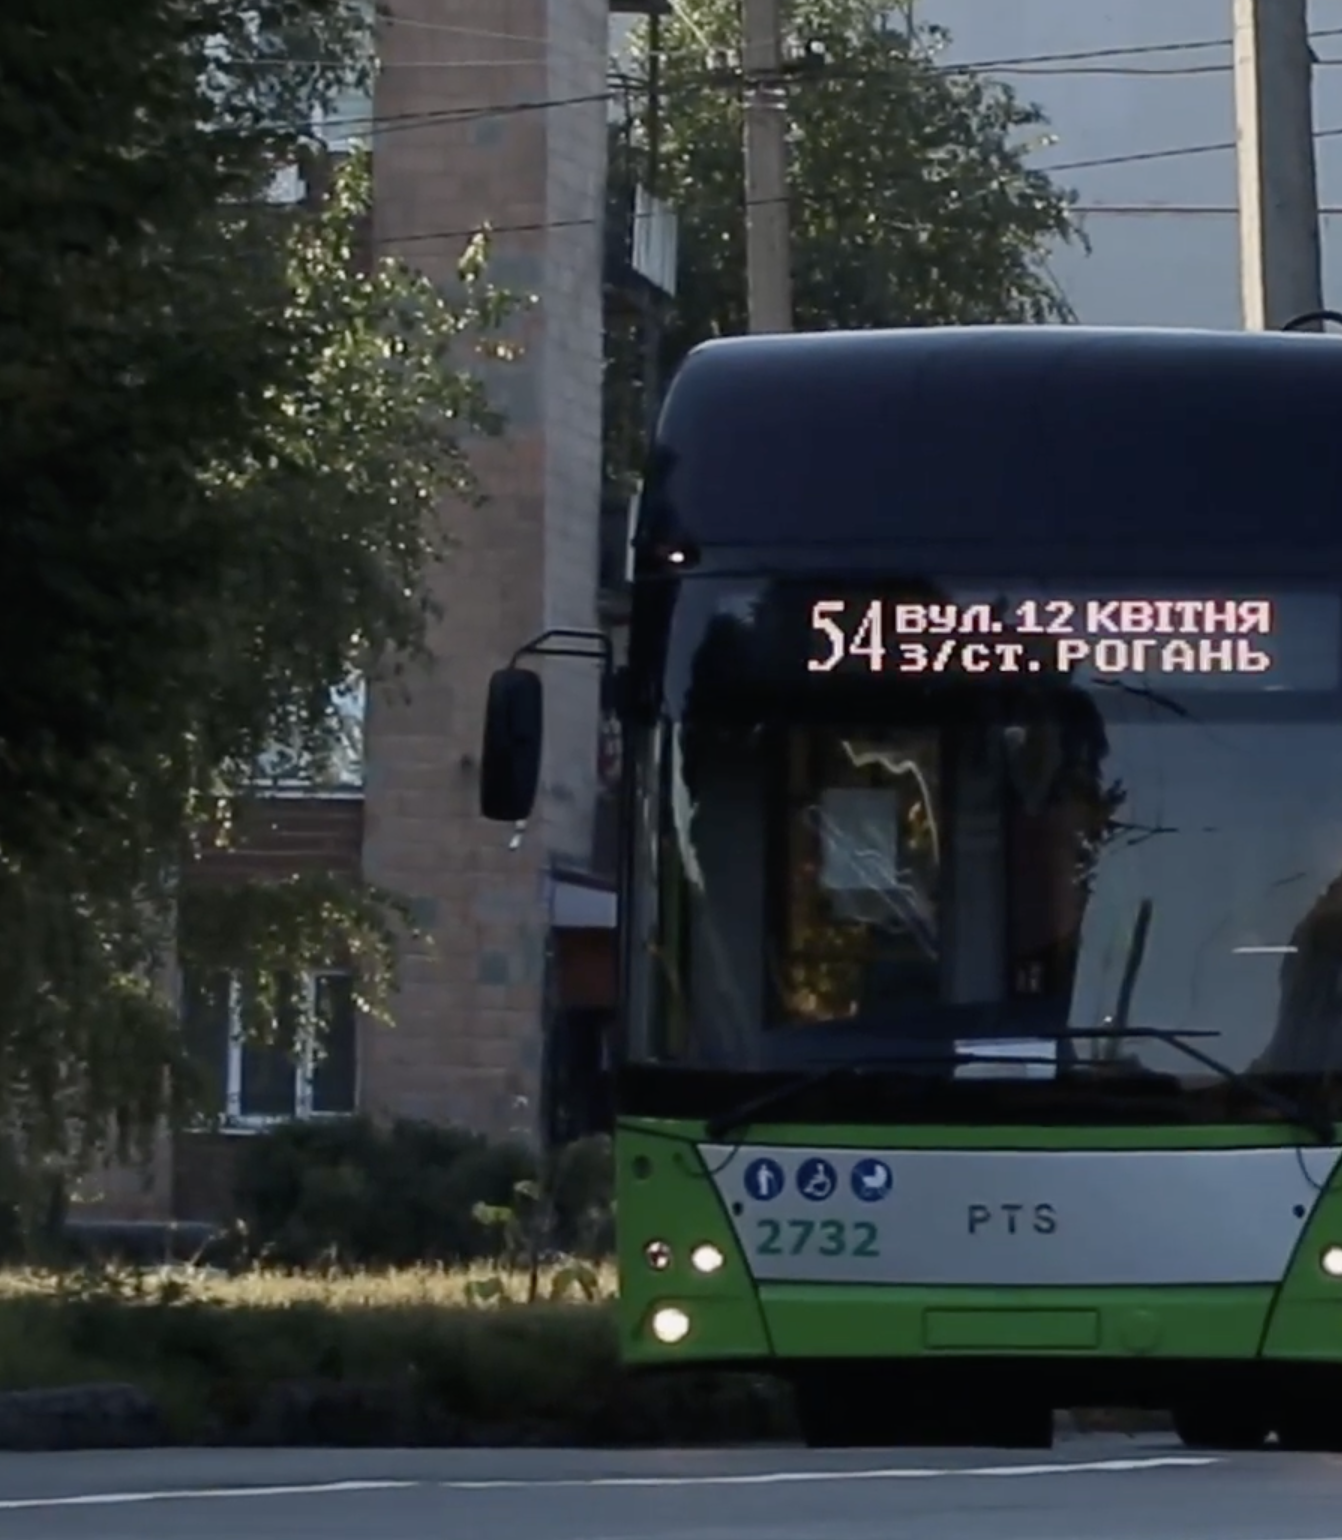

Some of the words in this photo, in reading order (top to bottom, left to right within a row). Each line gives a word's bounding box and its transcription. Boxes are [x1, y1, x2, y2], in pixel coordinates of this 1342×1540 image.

[1016, 600, 1075, 633] 12
[1087, 600, 1270, 633] КВІТНЯ
[808, 600, 886, 671] 54
[1057, 639, 1270, 672] РОГАНЬ
[968, 1203, 1058, 1235] PTS
[756, 1219, 881, 1258] 2732
